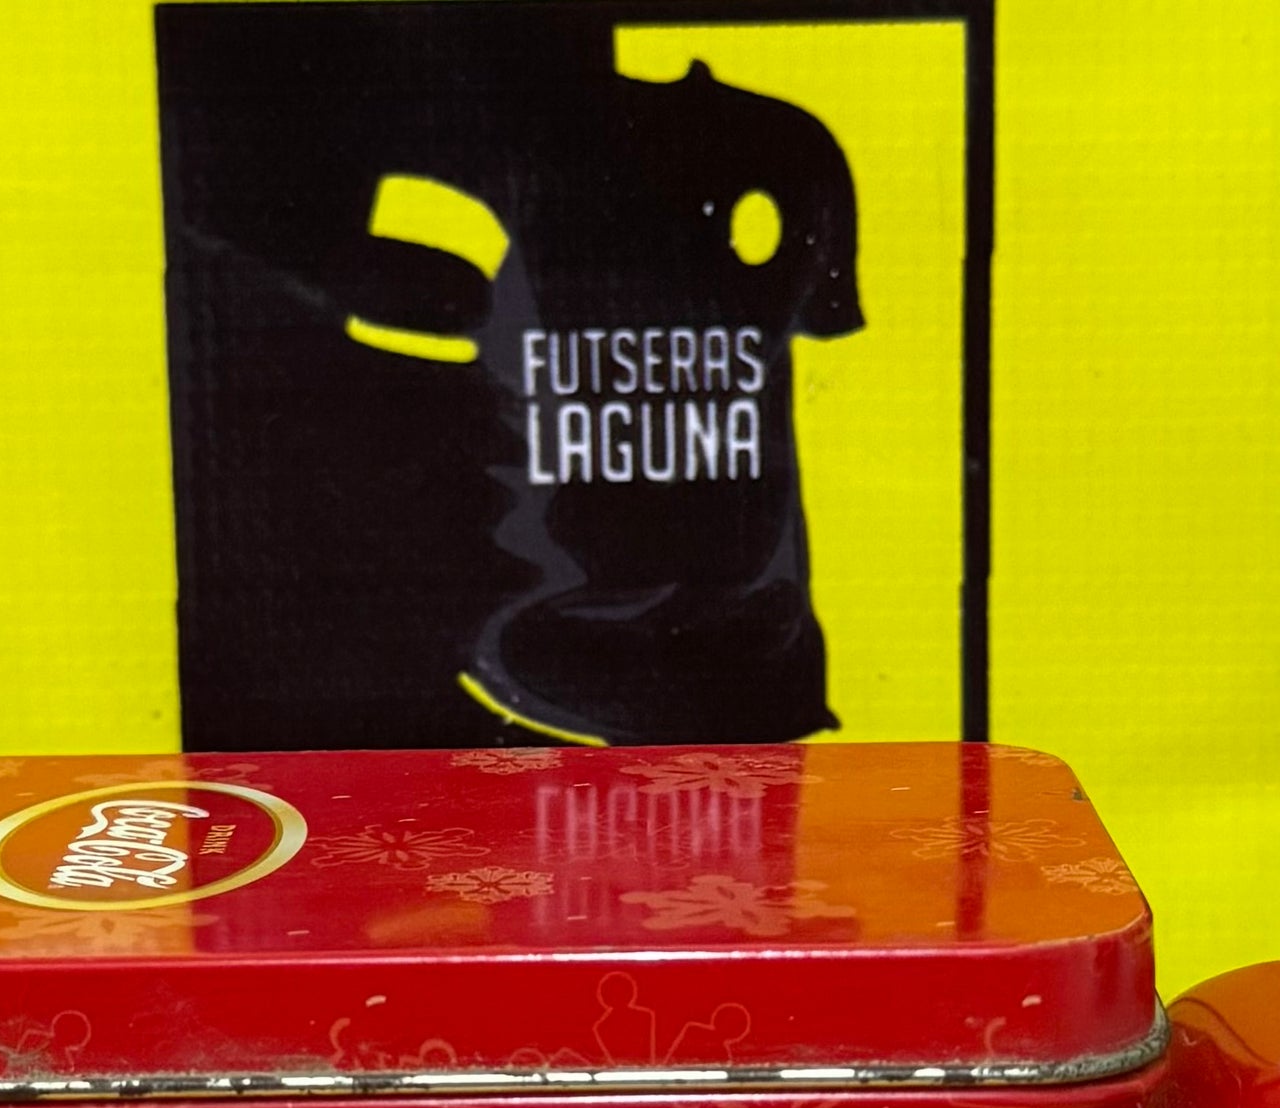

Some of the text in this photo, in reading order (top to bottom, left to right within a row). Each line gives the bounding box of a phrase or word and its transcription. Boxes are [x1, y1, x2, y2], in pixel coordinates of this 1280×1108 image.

[523, 327, 764, 396] FUTSERAS
[527, 400, 760, 484] LAGUNA
[48, 799, 211, 889] Coca-Cola
[199, 824, 237, 856] DRINK
